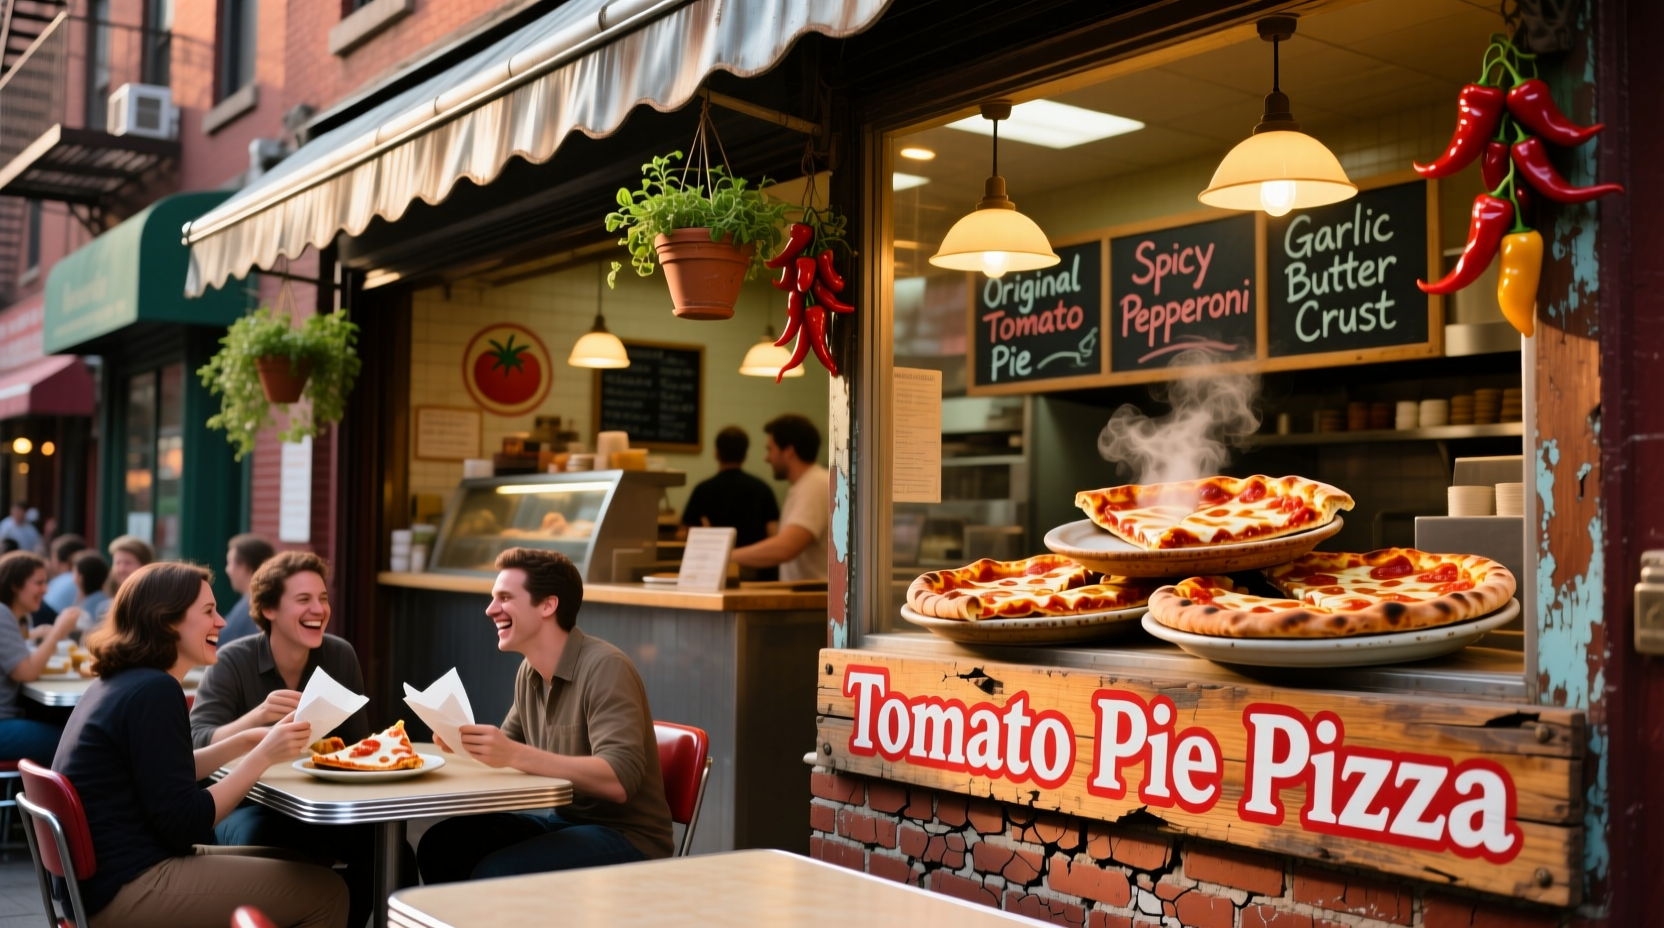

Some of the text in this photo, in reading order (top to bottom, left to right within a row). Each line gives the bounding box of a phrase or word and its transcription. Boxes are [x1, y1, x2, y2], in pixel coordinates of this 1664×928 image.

[1284, 203, 1395, 259] Garlic
[983, 254, 1081, 314] Original
[1132, 240, 1215, 295] Spicy
[1285, 251, 1397, 302] Butter
[982, 305, 1084, 343] Tomato
[1120, 279, 1250, 347] Pepperoni
[1296, 290, 1397, 342] Crust
[991, 345, 1033, 381] Pie
[847, 671, 1516, 855] Tomato Pie Pizza
